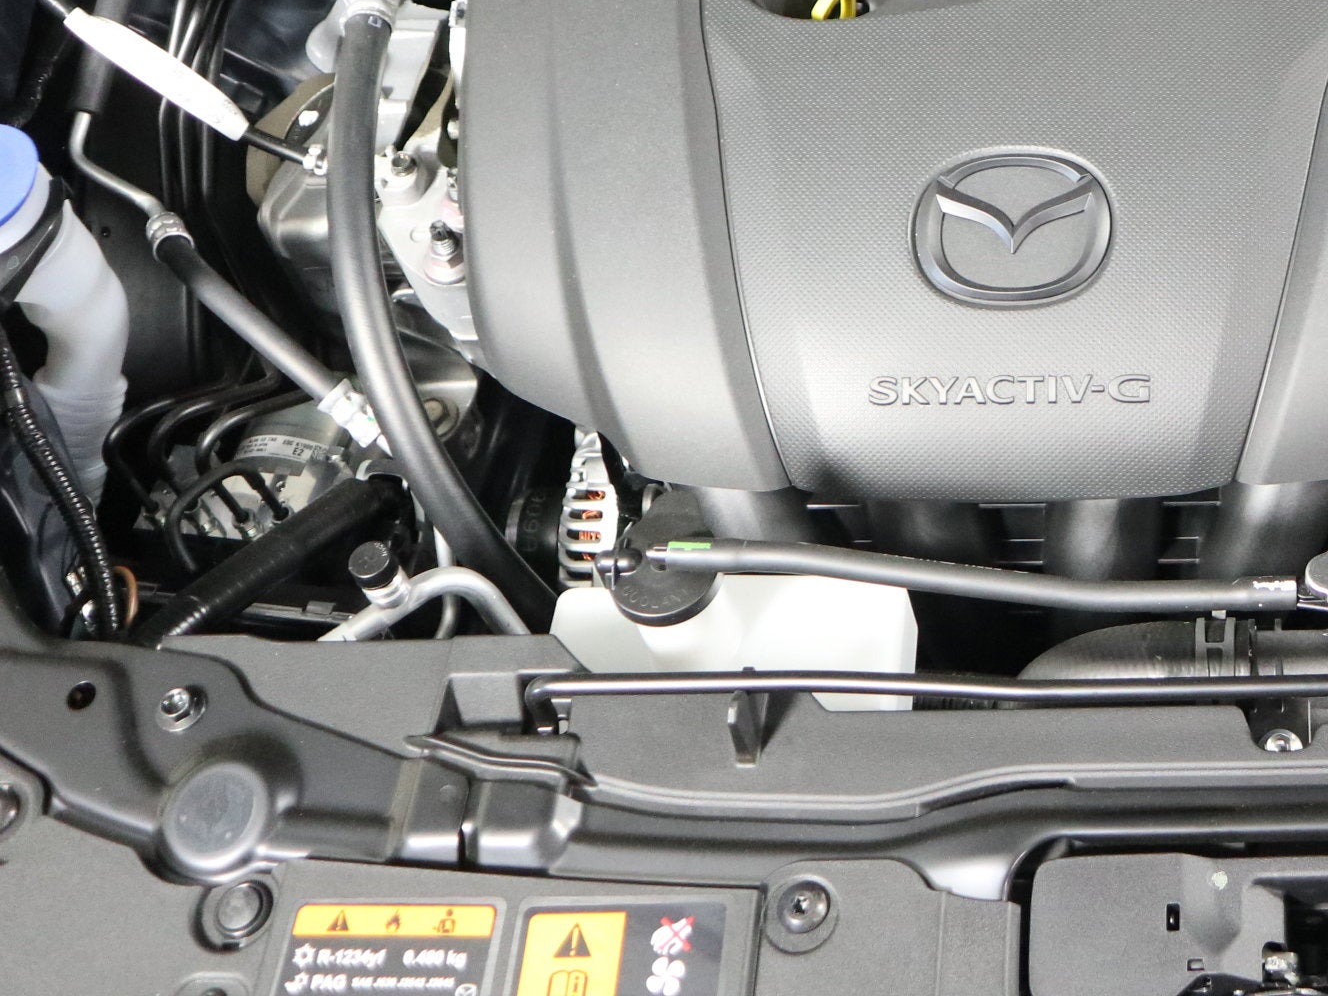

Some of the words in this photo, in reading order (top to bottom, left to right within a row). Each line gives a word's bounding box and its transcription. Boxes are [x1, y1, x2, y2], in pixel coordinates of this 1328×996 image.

[867, 373, 1152, 406] SKYACTIV-G
[316, 949, 387, 970] R-1234yf
[310, 974, 347, 992] PAG
